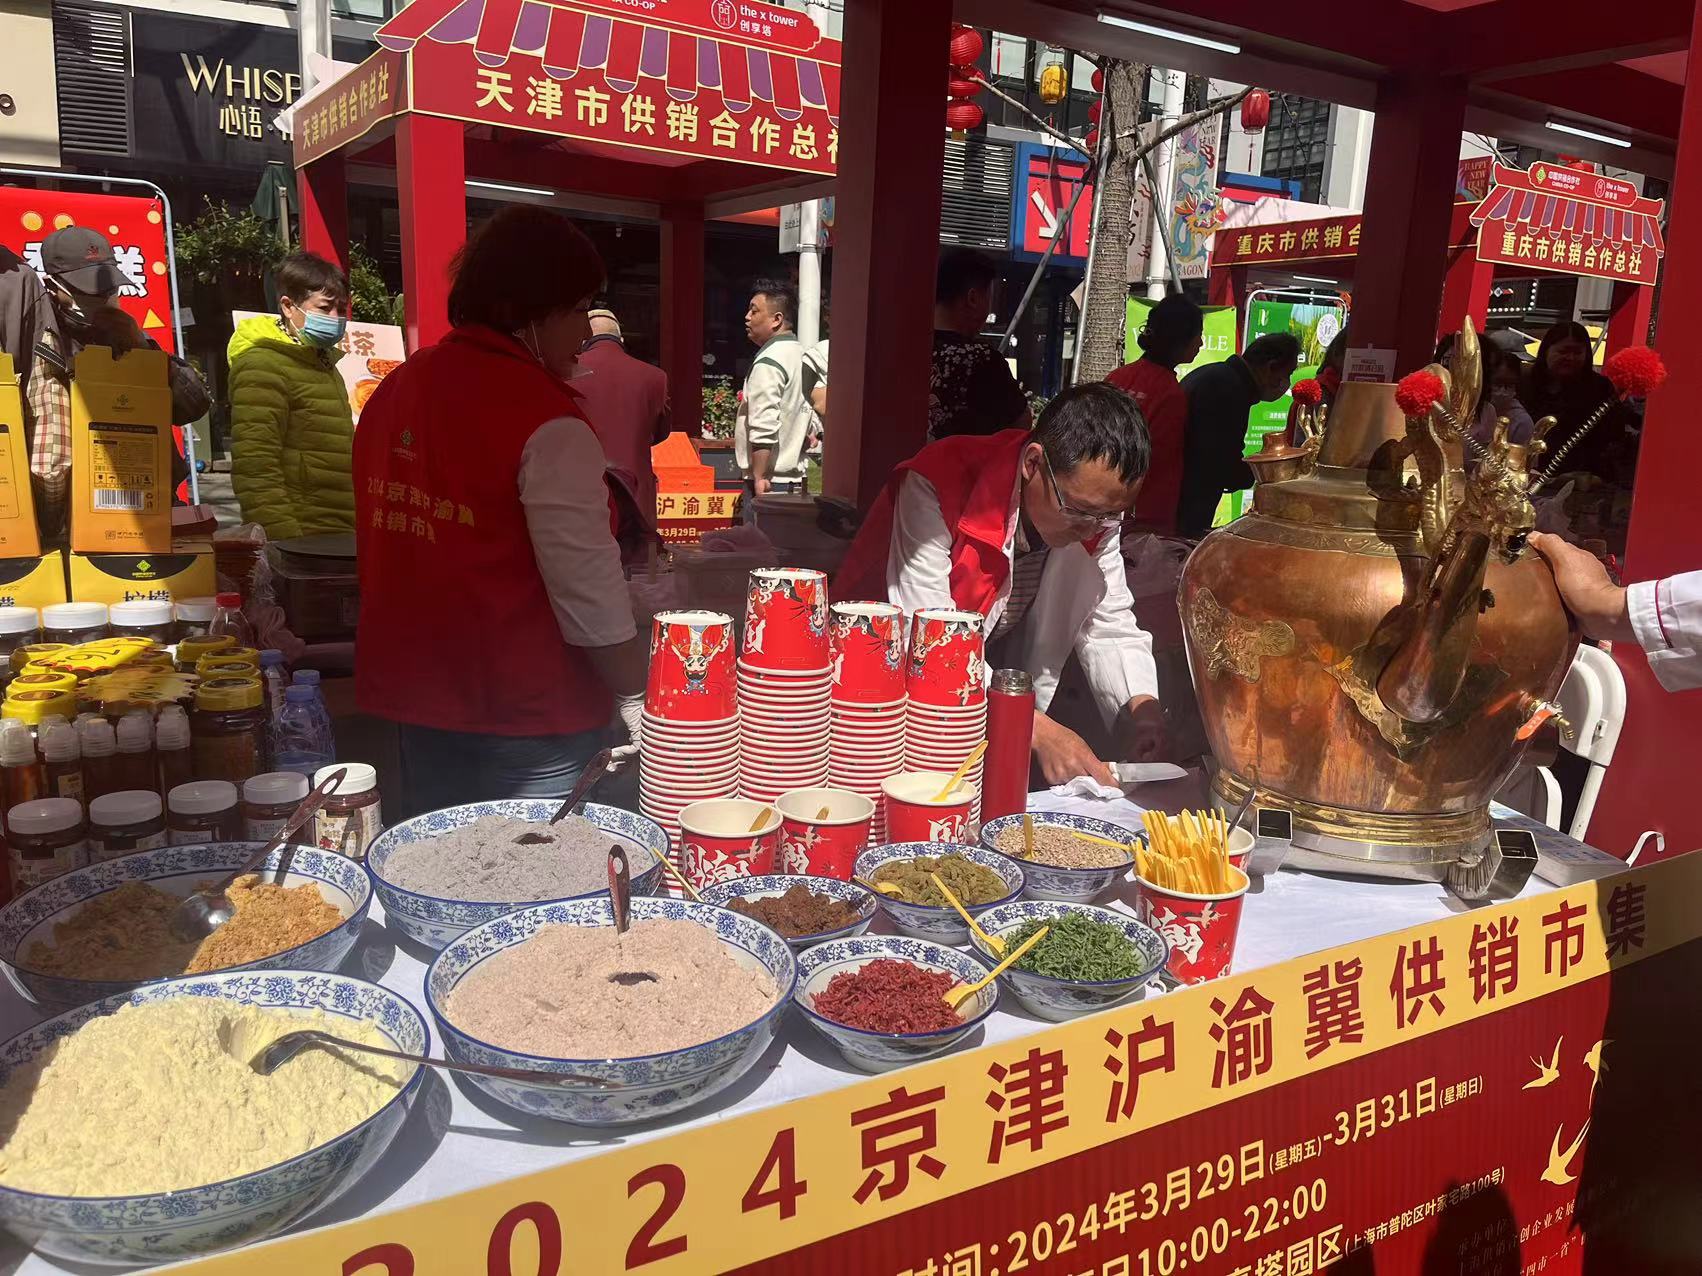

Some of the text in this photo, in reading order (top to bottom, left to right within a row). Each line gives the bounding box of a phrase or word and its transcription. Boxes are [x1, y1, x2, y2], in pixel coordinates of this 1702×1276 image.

[740, 5, 798, 28] the x tower
[740, 19, 772, 37] 创享塔
[303, 61, 389, 150] 天津市供销合作总社
[1464, 160, 1487, 171] HAPPY
[1470, 170, 1486, 180] NEW
[1500, 231, 1643, 277] 重庆市供销合作总社
